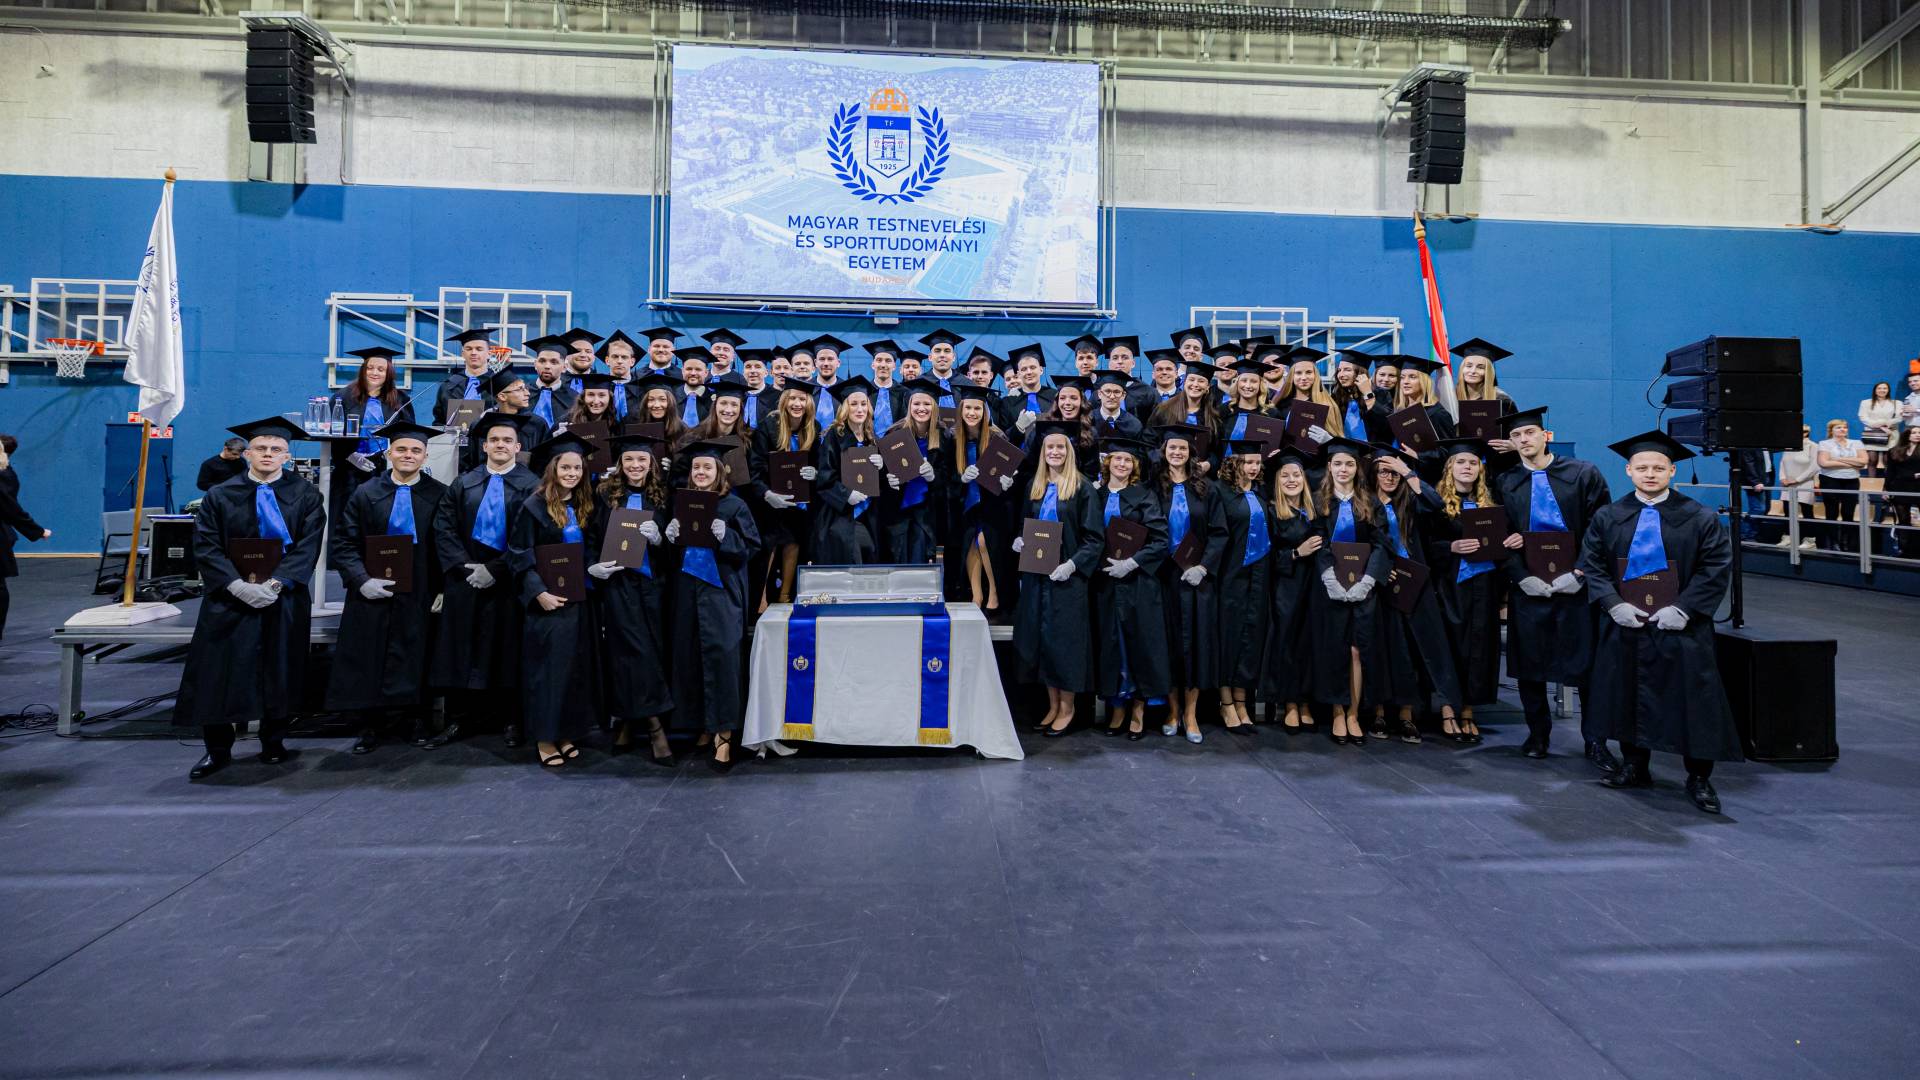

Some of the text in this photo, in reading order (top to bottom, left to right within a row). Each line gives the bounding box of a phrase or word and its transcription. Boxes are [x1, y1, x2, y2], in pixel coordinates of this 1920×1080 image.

[884, 119, 895, 127] TF
[788, 215, 986, 234] MAGYAR TESTNEVELÉSI
[795, 231, 978, 253] ÉS SPORTTUDOMÁNYI
[848, 255, 926, 271] EGYETEM
